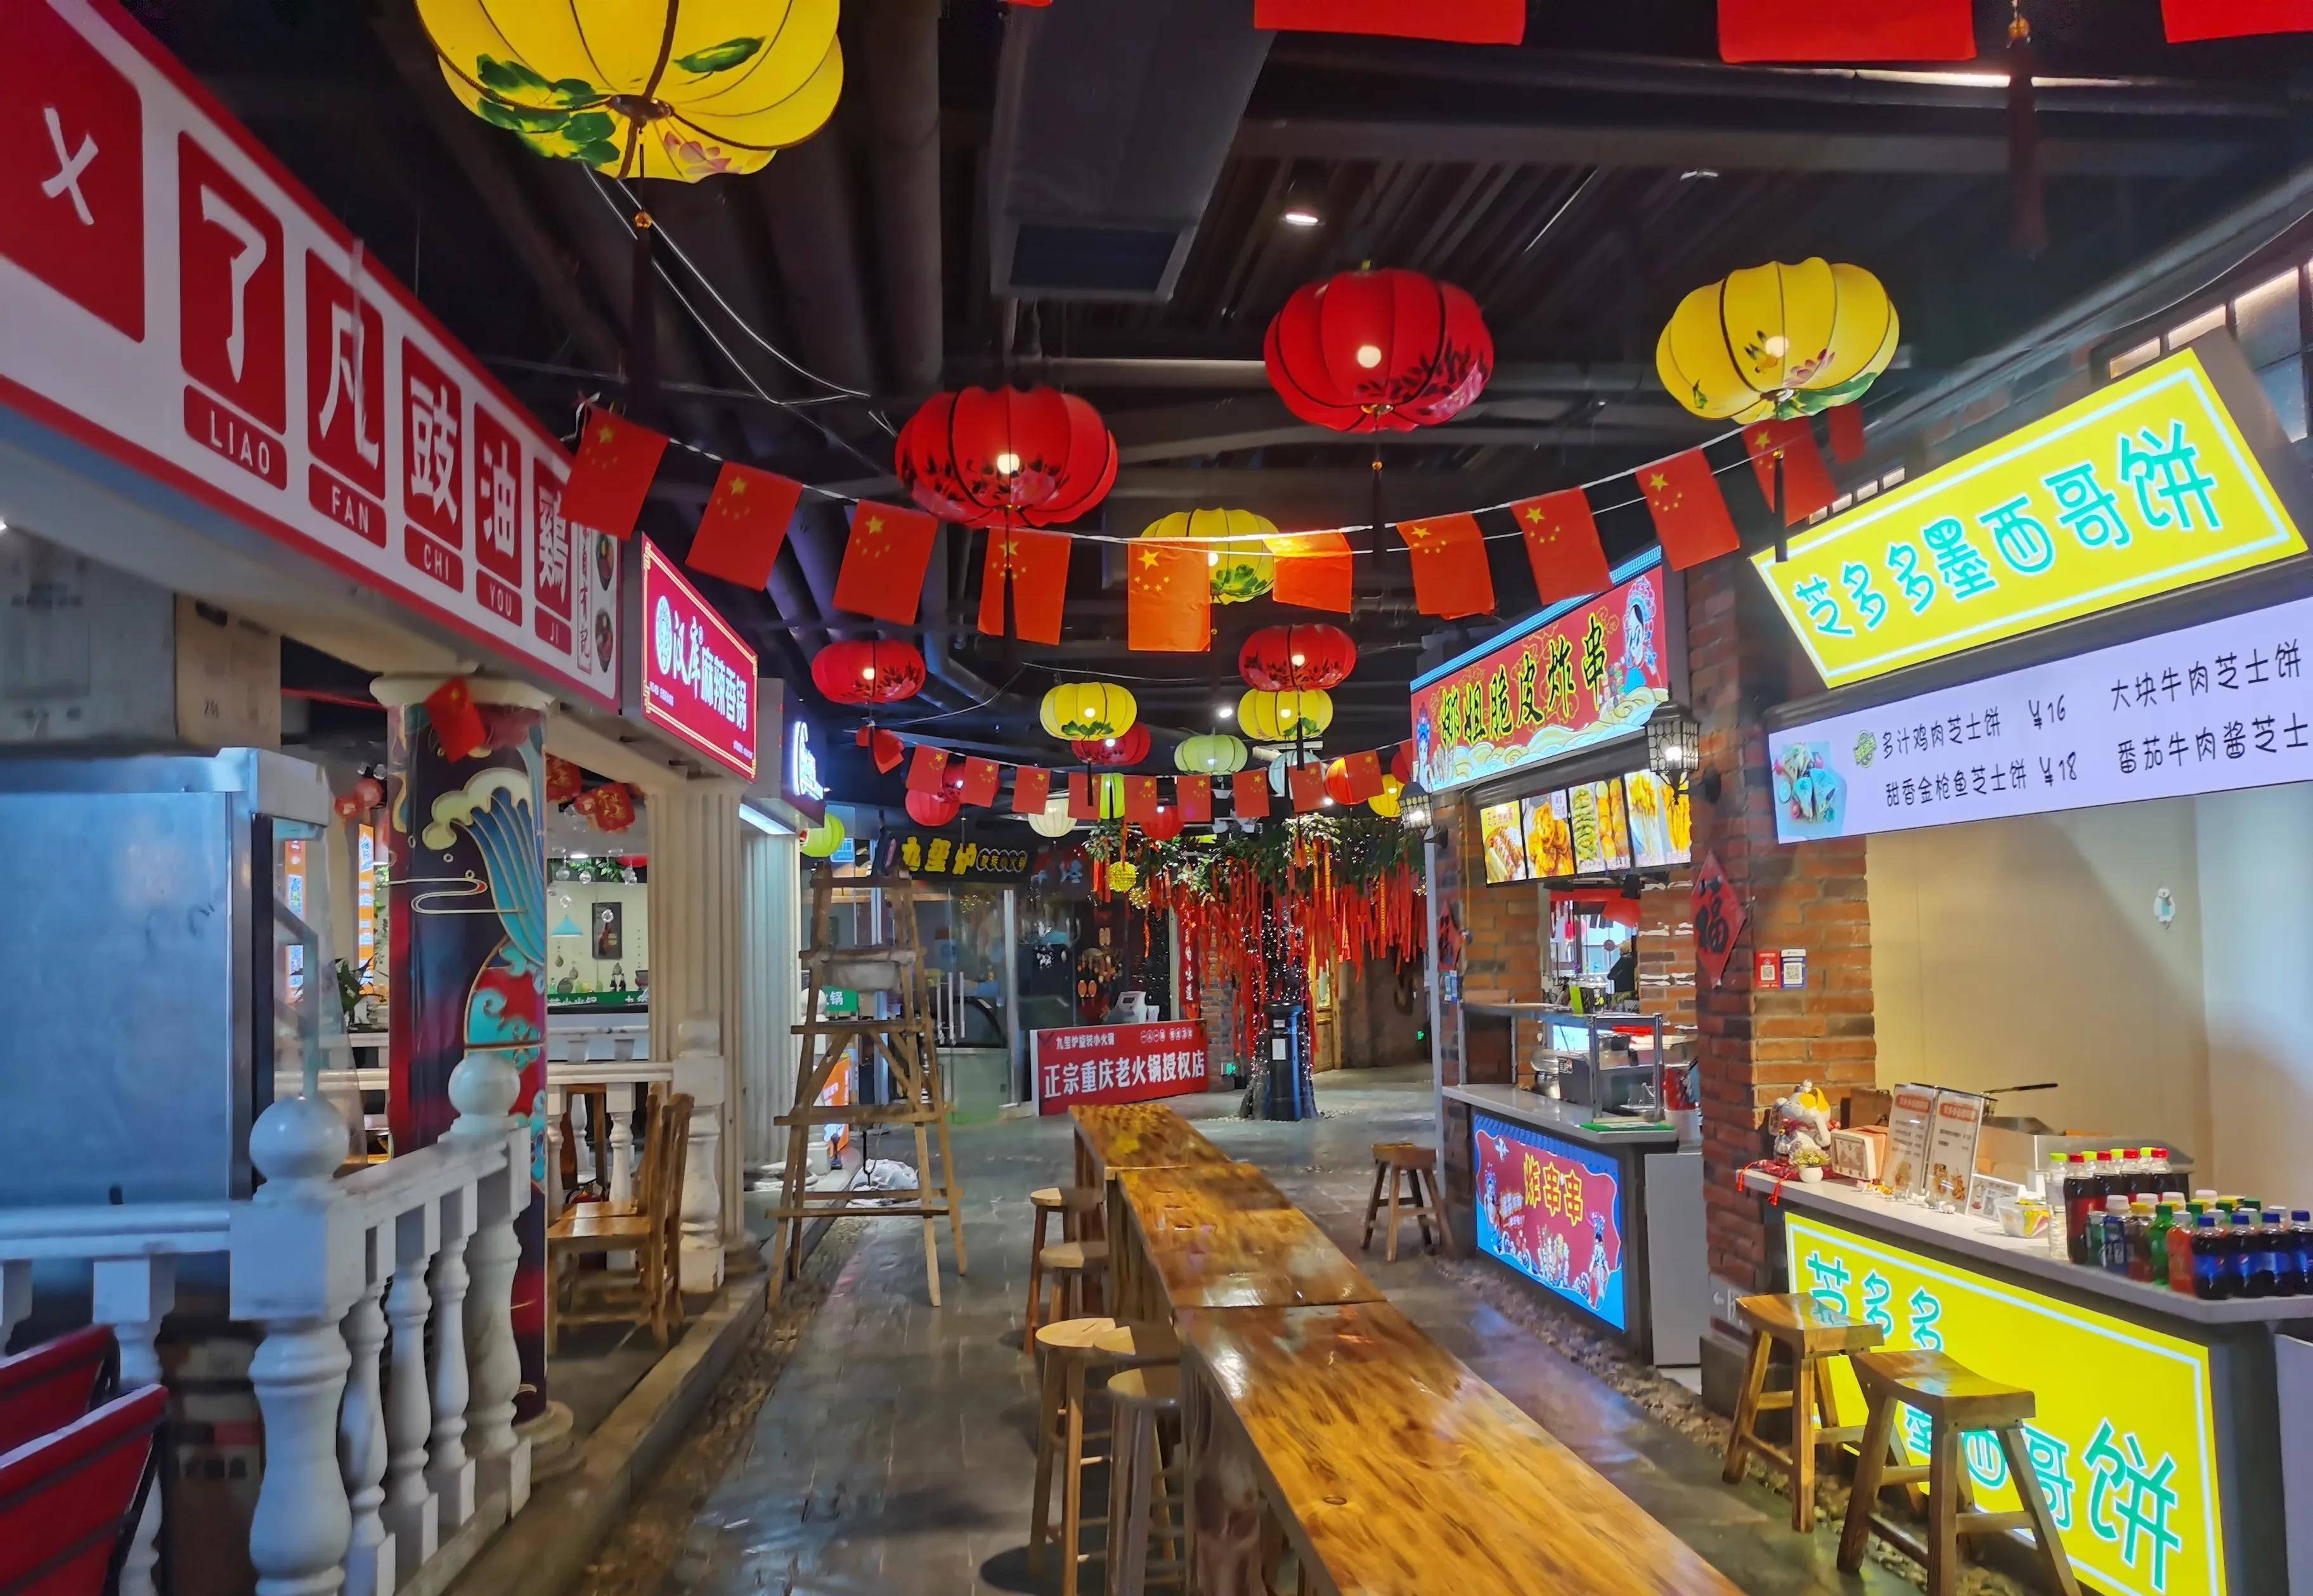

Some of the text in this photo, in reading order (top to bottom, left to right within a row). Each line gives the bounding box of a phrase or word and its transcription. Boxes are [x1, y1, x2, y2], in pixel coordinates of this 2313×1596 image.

[211, 412, 559, 645] LIAO FAN CHI YOU JI
[1794, 420, 2223, 639] 芝多多墨西哥饼
[2111, 638, 2302, 711] 大块牛肉芝士饼
[1881, 705, 2002, 759] 多汁鸡肉芝士饼
[2117, 712, 2309, 774] 番茄牛肉酱芝士
[1885, 758, 2028, 807] 甜香金枪鱼芝士饼
[1695, 875, 1729, 954] 福
[826, 990, 843, 1006] 锅
[1044, 1049, 1205, 1099] 正宗重庆老火锅授权店
